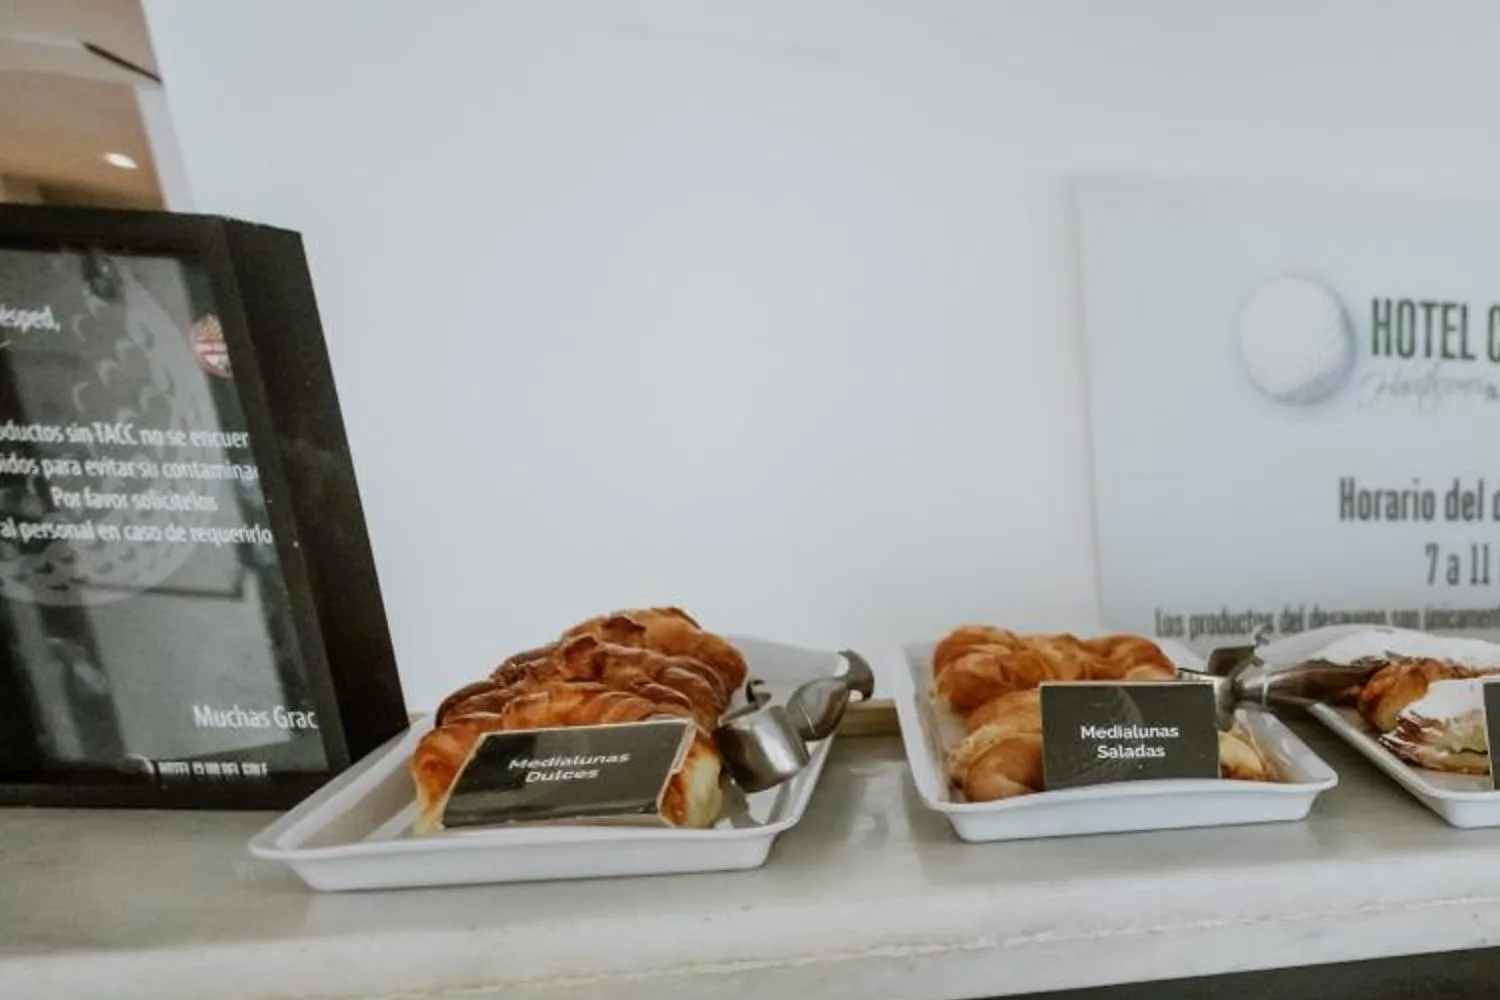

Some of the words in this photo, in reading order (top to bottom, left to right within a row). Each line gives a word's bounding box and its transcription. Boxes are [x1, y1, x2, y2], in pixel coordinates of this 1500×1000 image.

[1370, 297, 1476, 361] HOTEL
[65, 423, 93, 443] sin
[91, 421, 138, 446] TACC
[139, 429, 163, 446] no
[167, 430, 187, 447] se
[41, 459, 82, 480] para
[84, 457, 136, 478] evitar
[137, 462, 159, 479] su
[50, 485, 82, 508] Por
[83, 485, 129, 509] favor
[1338, 476, 1436, 522] Horario
[1444, 477, 1485, 522] del
[18, 519, 95, 543] personal
[97, 524, 121, 541] en
[124, 525, 162, 542] caso
[164, 523, 187, 543] de
[189, 523, 274, 549] requerirlo
[1424, 541, 1440, 586] 7
[1445, 552, 1460, 586] a
[1469, 542, 1490, 586] 11
[1153, 606, 1185, 638] Los
[1279, 602, 1306, 634] del
[192, 704, 270, 728] Muchas
[273, 704, 320, 729] Grac
[1080, 724, 1180, 740] Medialunas
[508, 752, 631, 770] Medialunas
[1096, 744, 1166, 760] Saladas
[525, 768, 600, 784] Dulces
